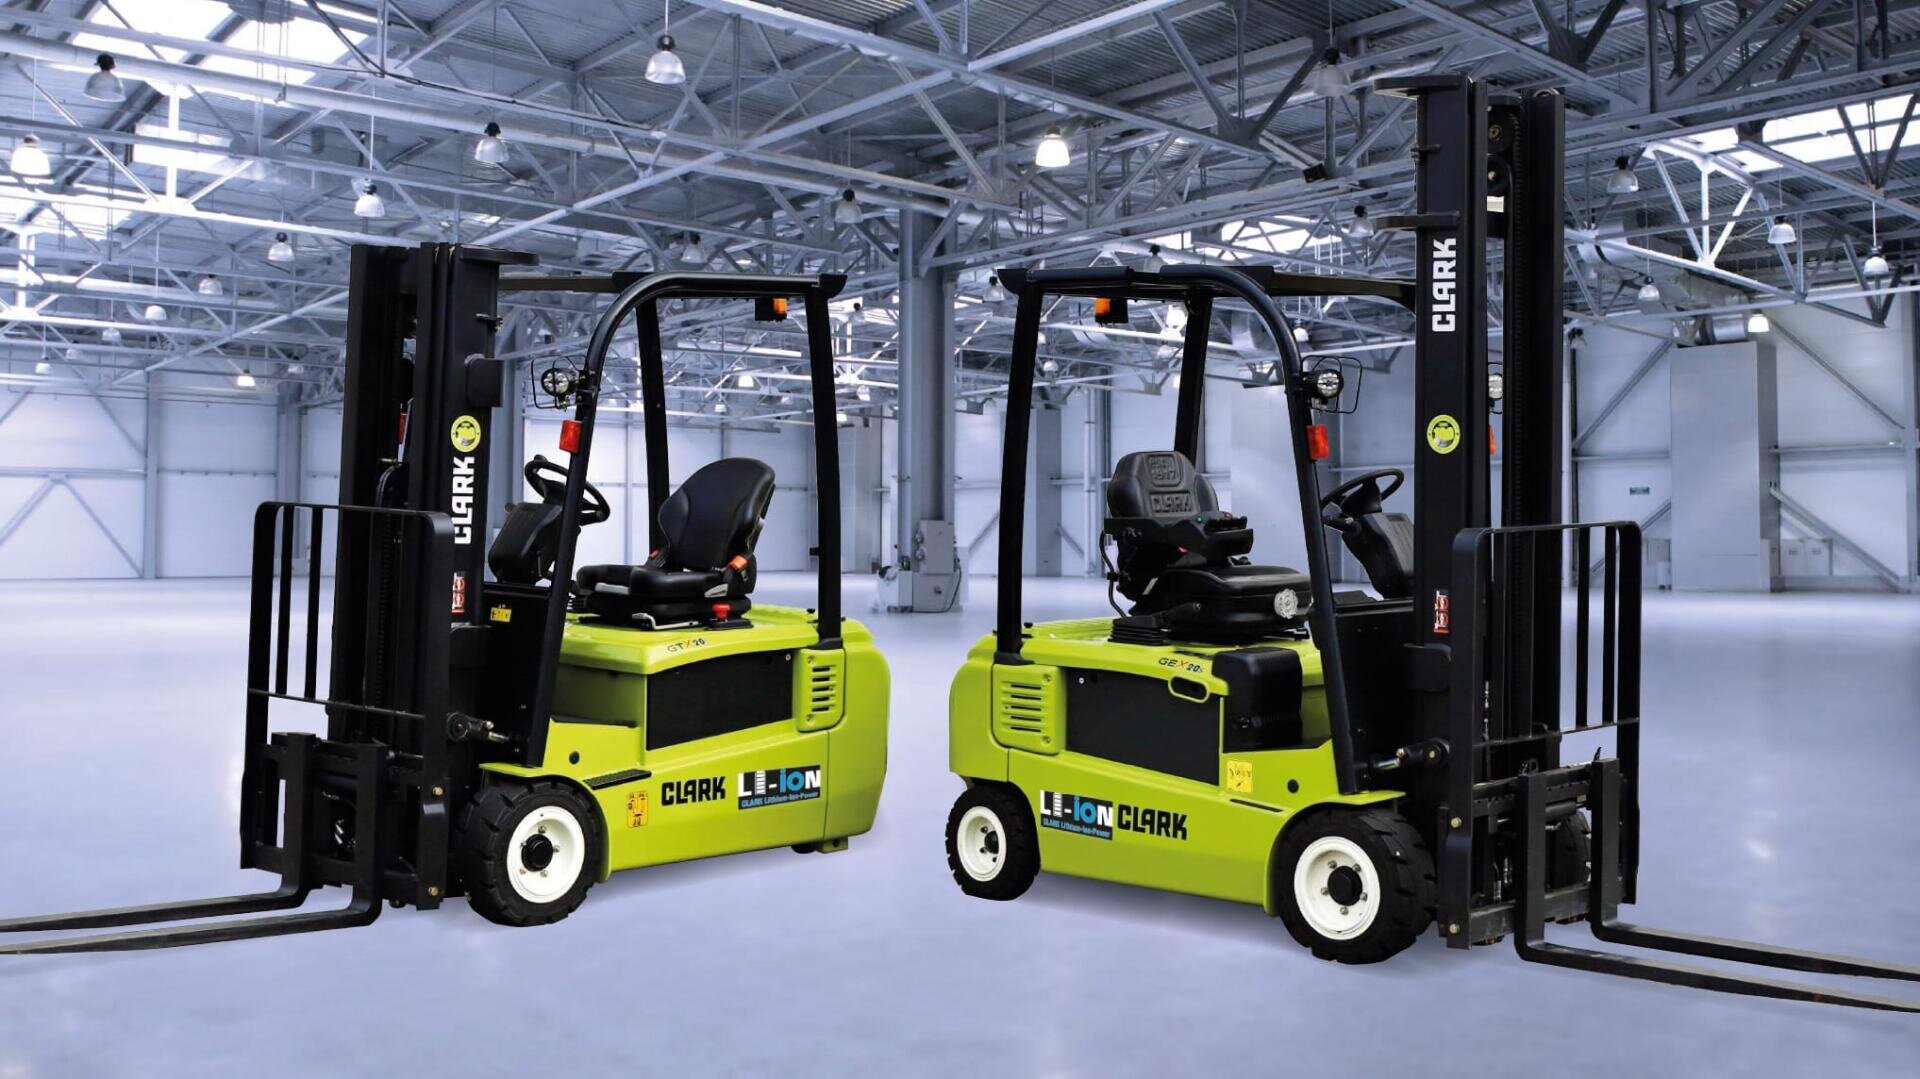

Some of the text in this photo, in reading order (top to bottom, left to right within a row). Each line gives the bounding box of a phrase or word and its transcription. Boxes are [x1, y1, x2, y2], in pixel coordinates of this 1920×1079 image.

[1431, 237, 1457, 333] CLARK
[451, 456, 476, 545] CLARK
[661, 776, 726, 807] CLARK
[1117, 804, 1188, 841] CLARK
